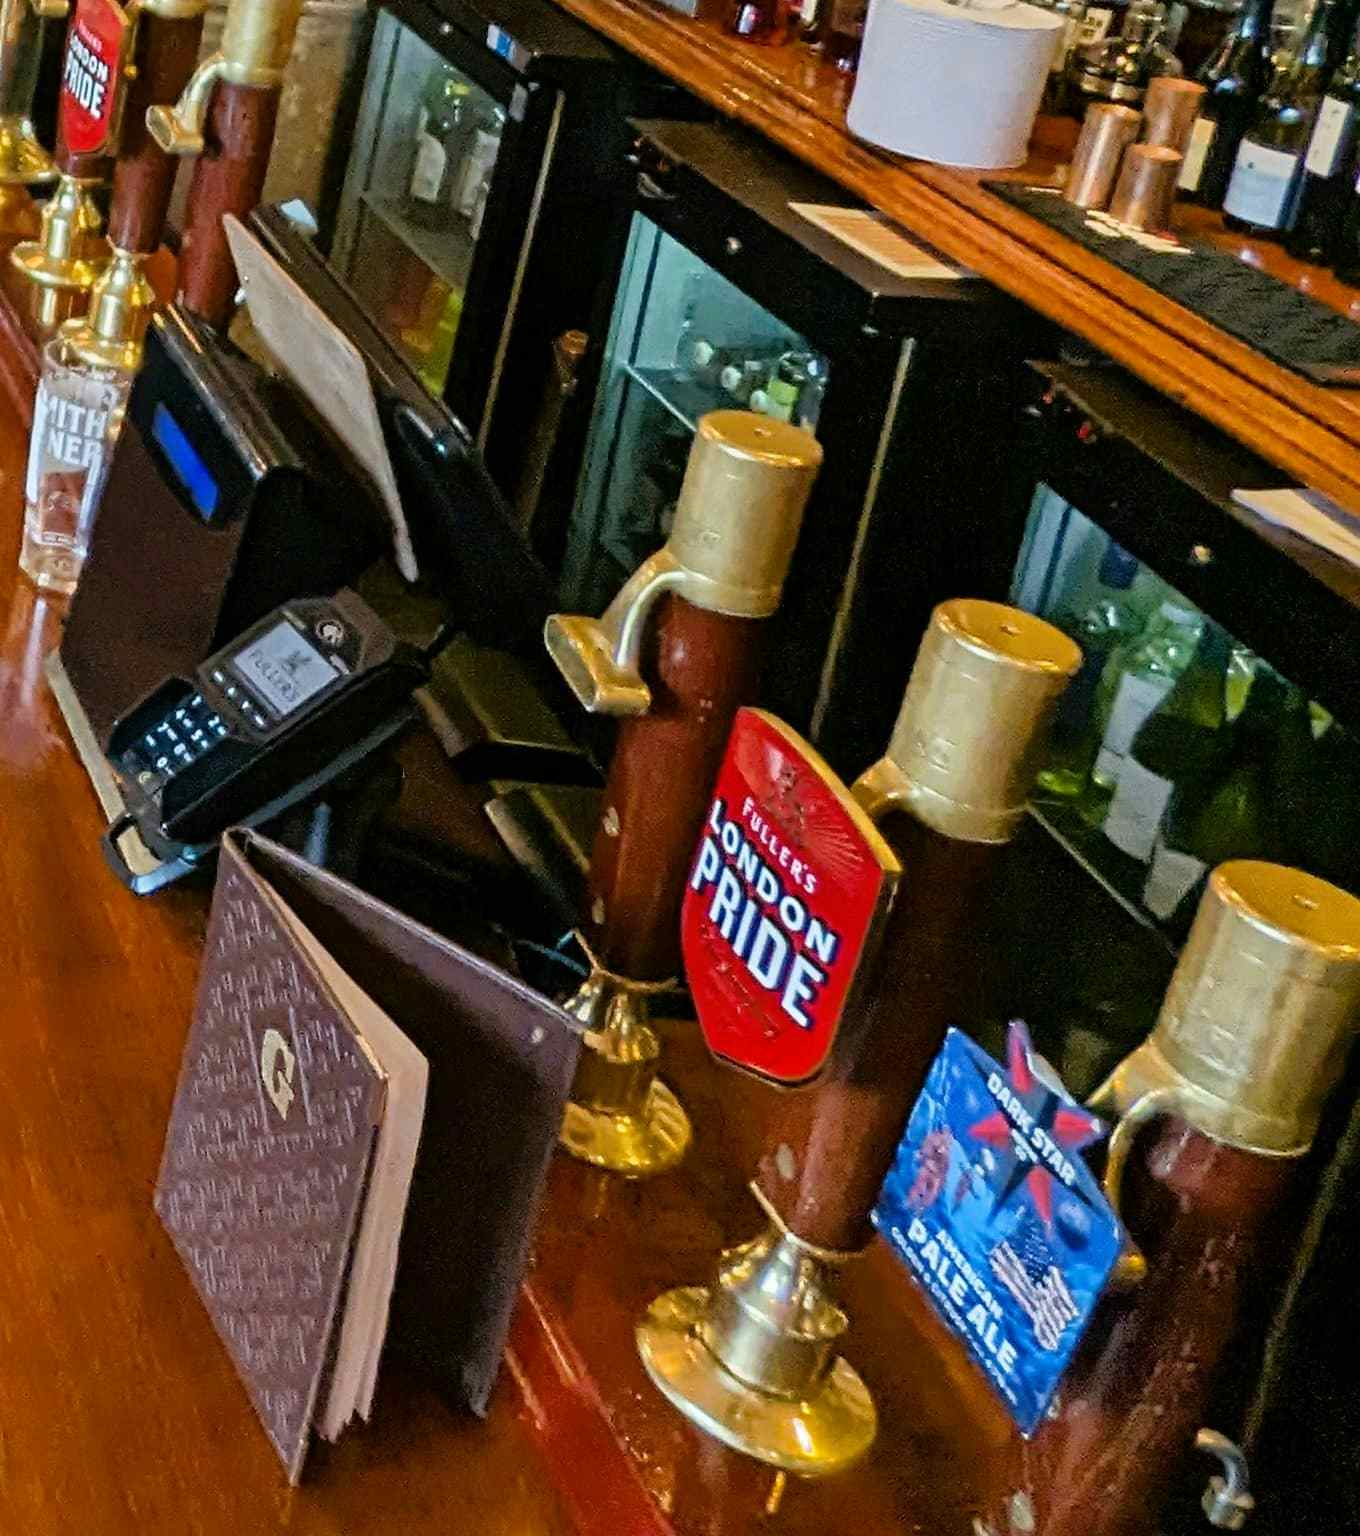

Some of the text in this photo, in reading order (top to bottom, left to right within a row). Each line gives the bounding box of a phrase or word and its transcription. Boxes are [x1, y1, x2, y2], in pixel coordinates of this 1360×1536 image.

[64, 49, 105, 120] PRIDE
[708, 798, 838, 964] LONDON
[741, 795, 818, 895] FULLER'S
[690, 836, 825, 1029] PRIDE
[261, 1028, 295, 1121] G
[986, 1071, 1037, 1135] DARK
[1029, 1126, 1077, 1186] STAR
[907, 1216, 969, 1307] PALE
[966, 1303, 1019, 1375] ALE
[936, 1228, 1004, 1320] AMERICAN
